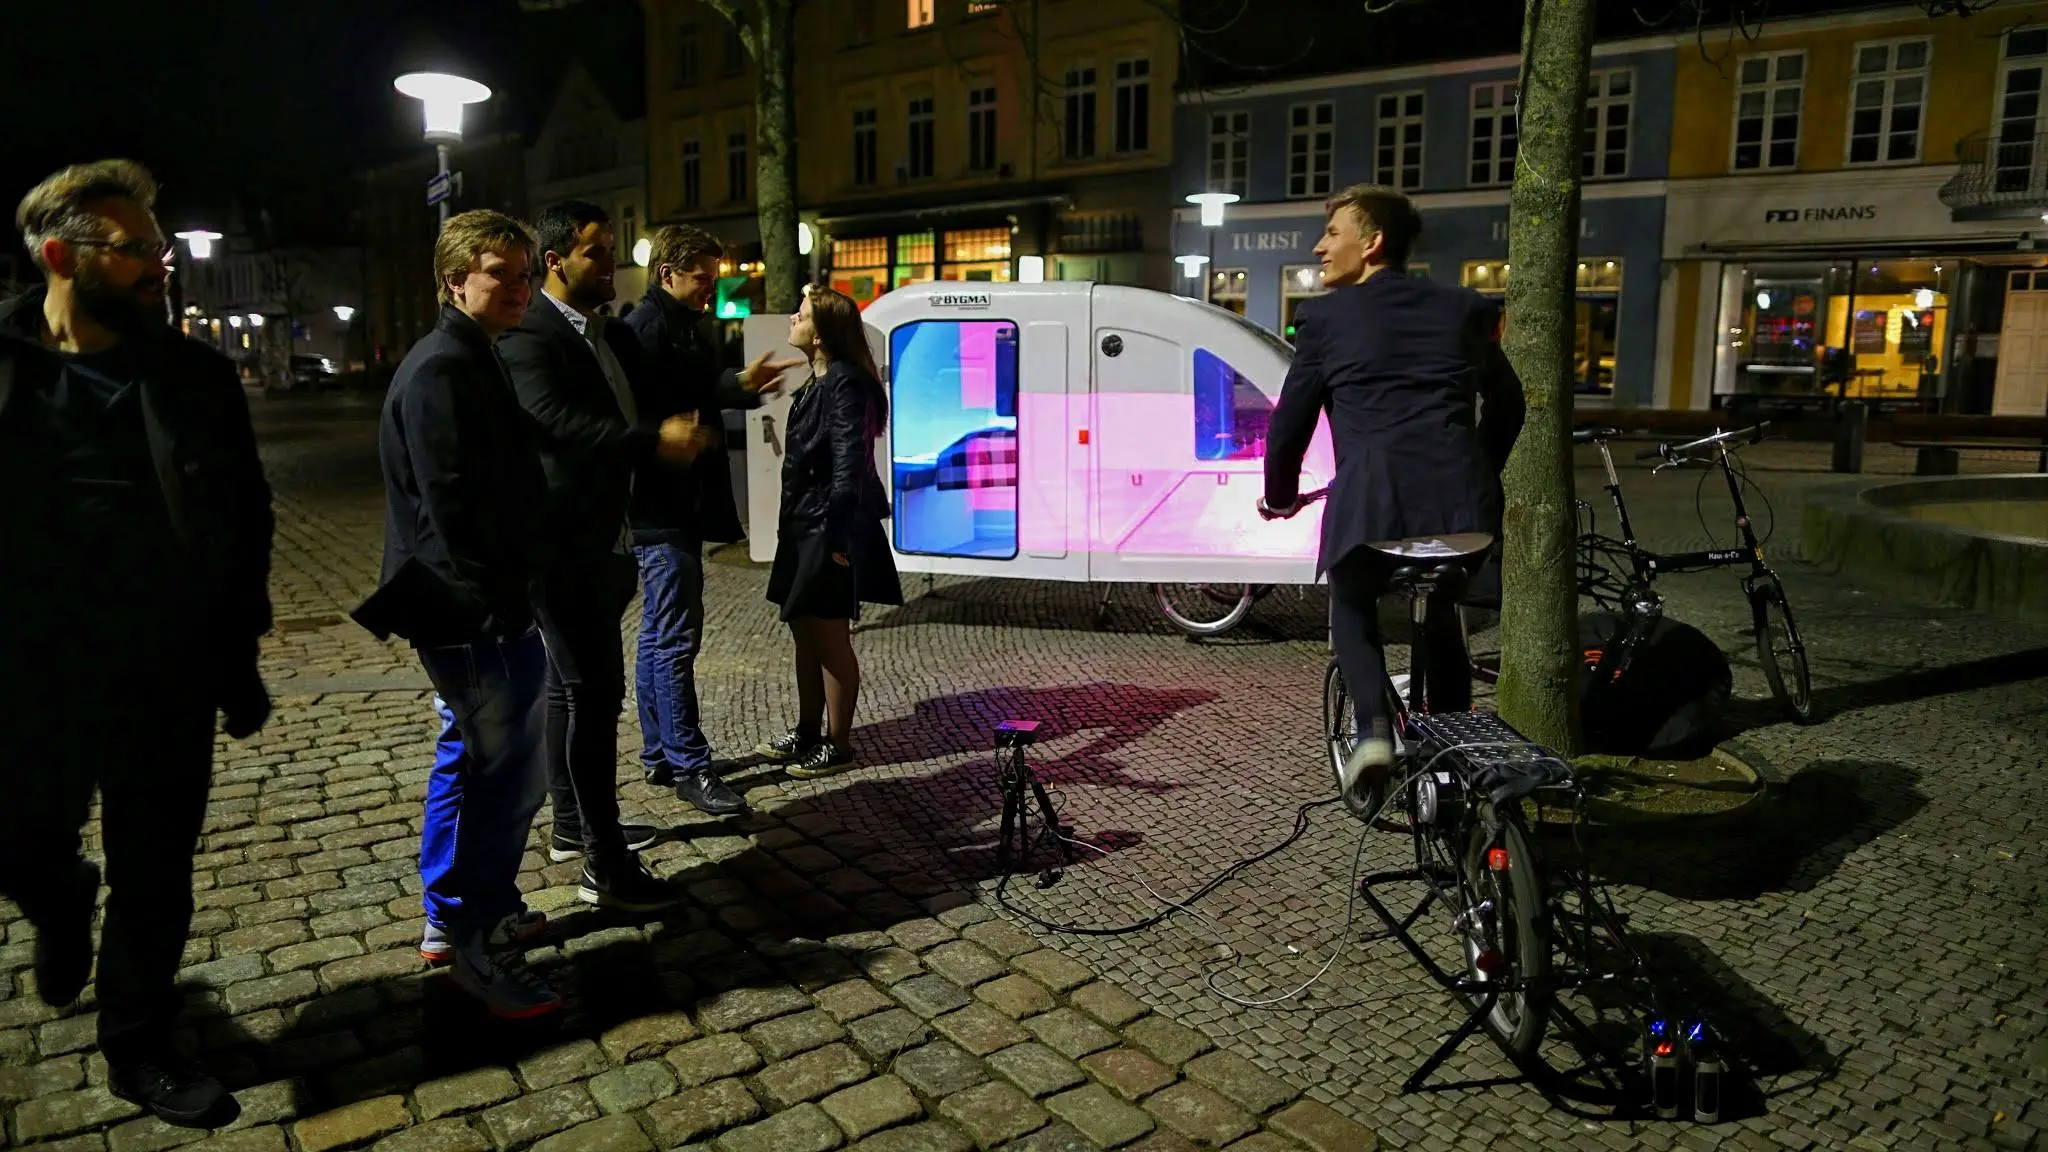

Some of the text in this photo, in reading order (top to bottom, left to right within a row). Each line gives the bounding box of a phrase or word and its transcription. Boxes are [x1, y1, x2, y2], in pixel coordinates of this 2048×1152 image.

[1804, 205, 1877, 221] FINANS
[1230, 231, 1303, 251] TURIST
[944, 295, 988, 304] BYGMA
